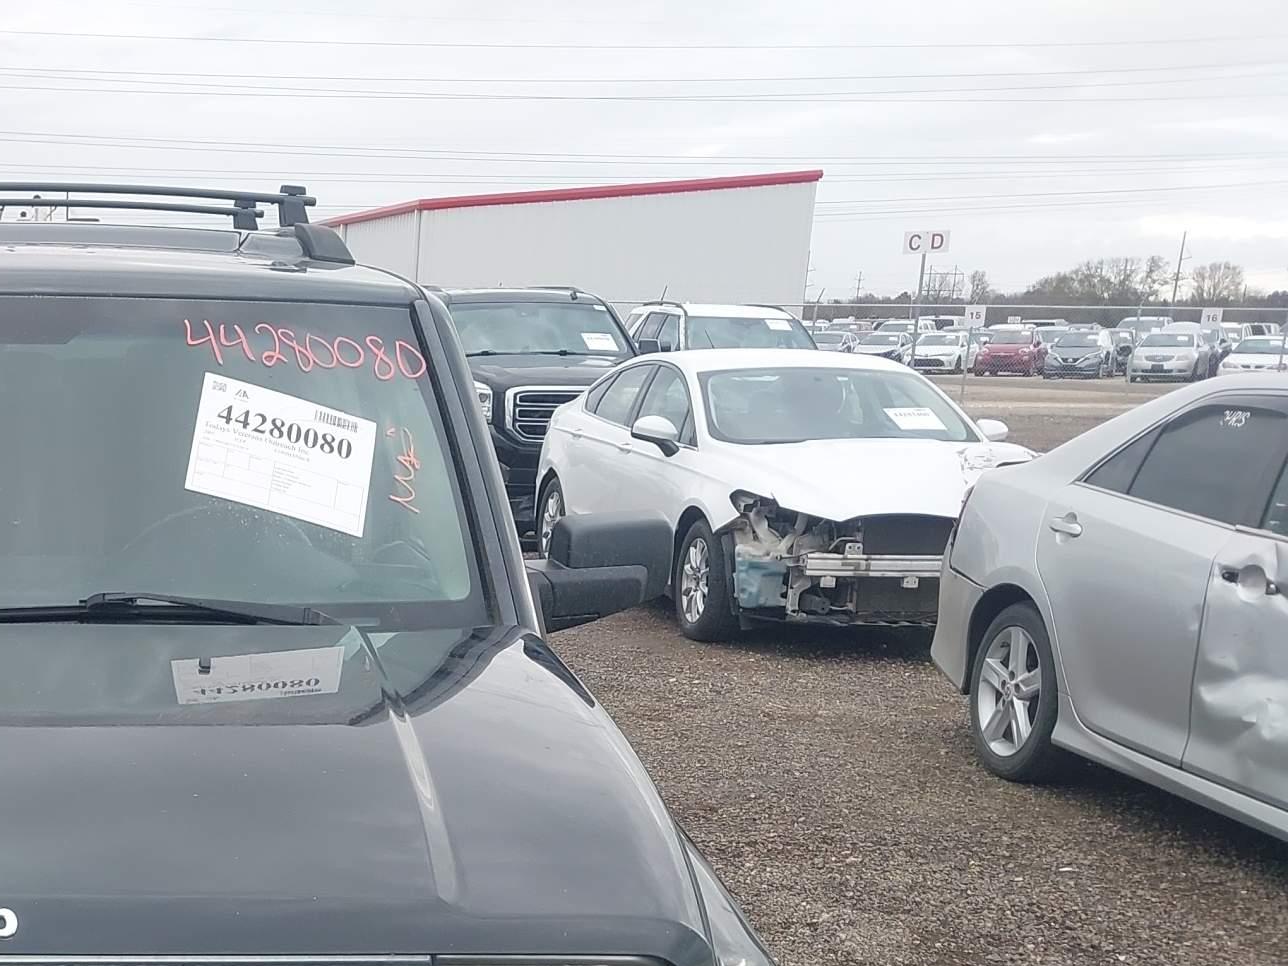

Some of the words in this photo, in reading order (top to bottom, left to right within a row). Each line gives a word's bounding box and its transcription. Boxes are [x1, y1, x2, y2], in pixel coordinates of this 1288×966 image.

[908, 233, 922, 252] C
[930, 232, 944, 250] D
[970, 311, 982, 320] 15
[1207, 314, 1218, 322] 16
[184, 319, 427, 380] 44280080
[217, 404, 353, 459] 44280080
